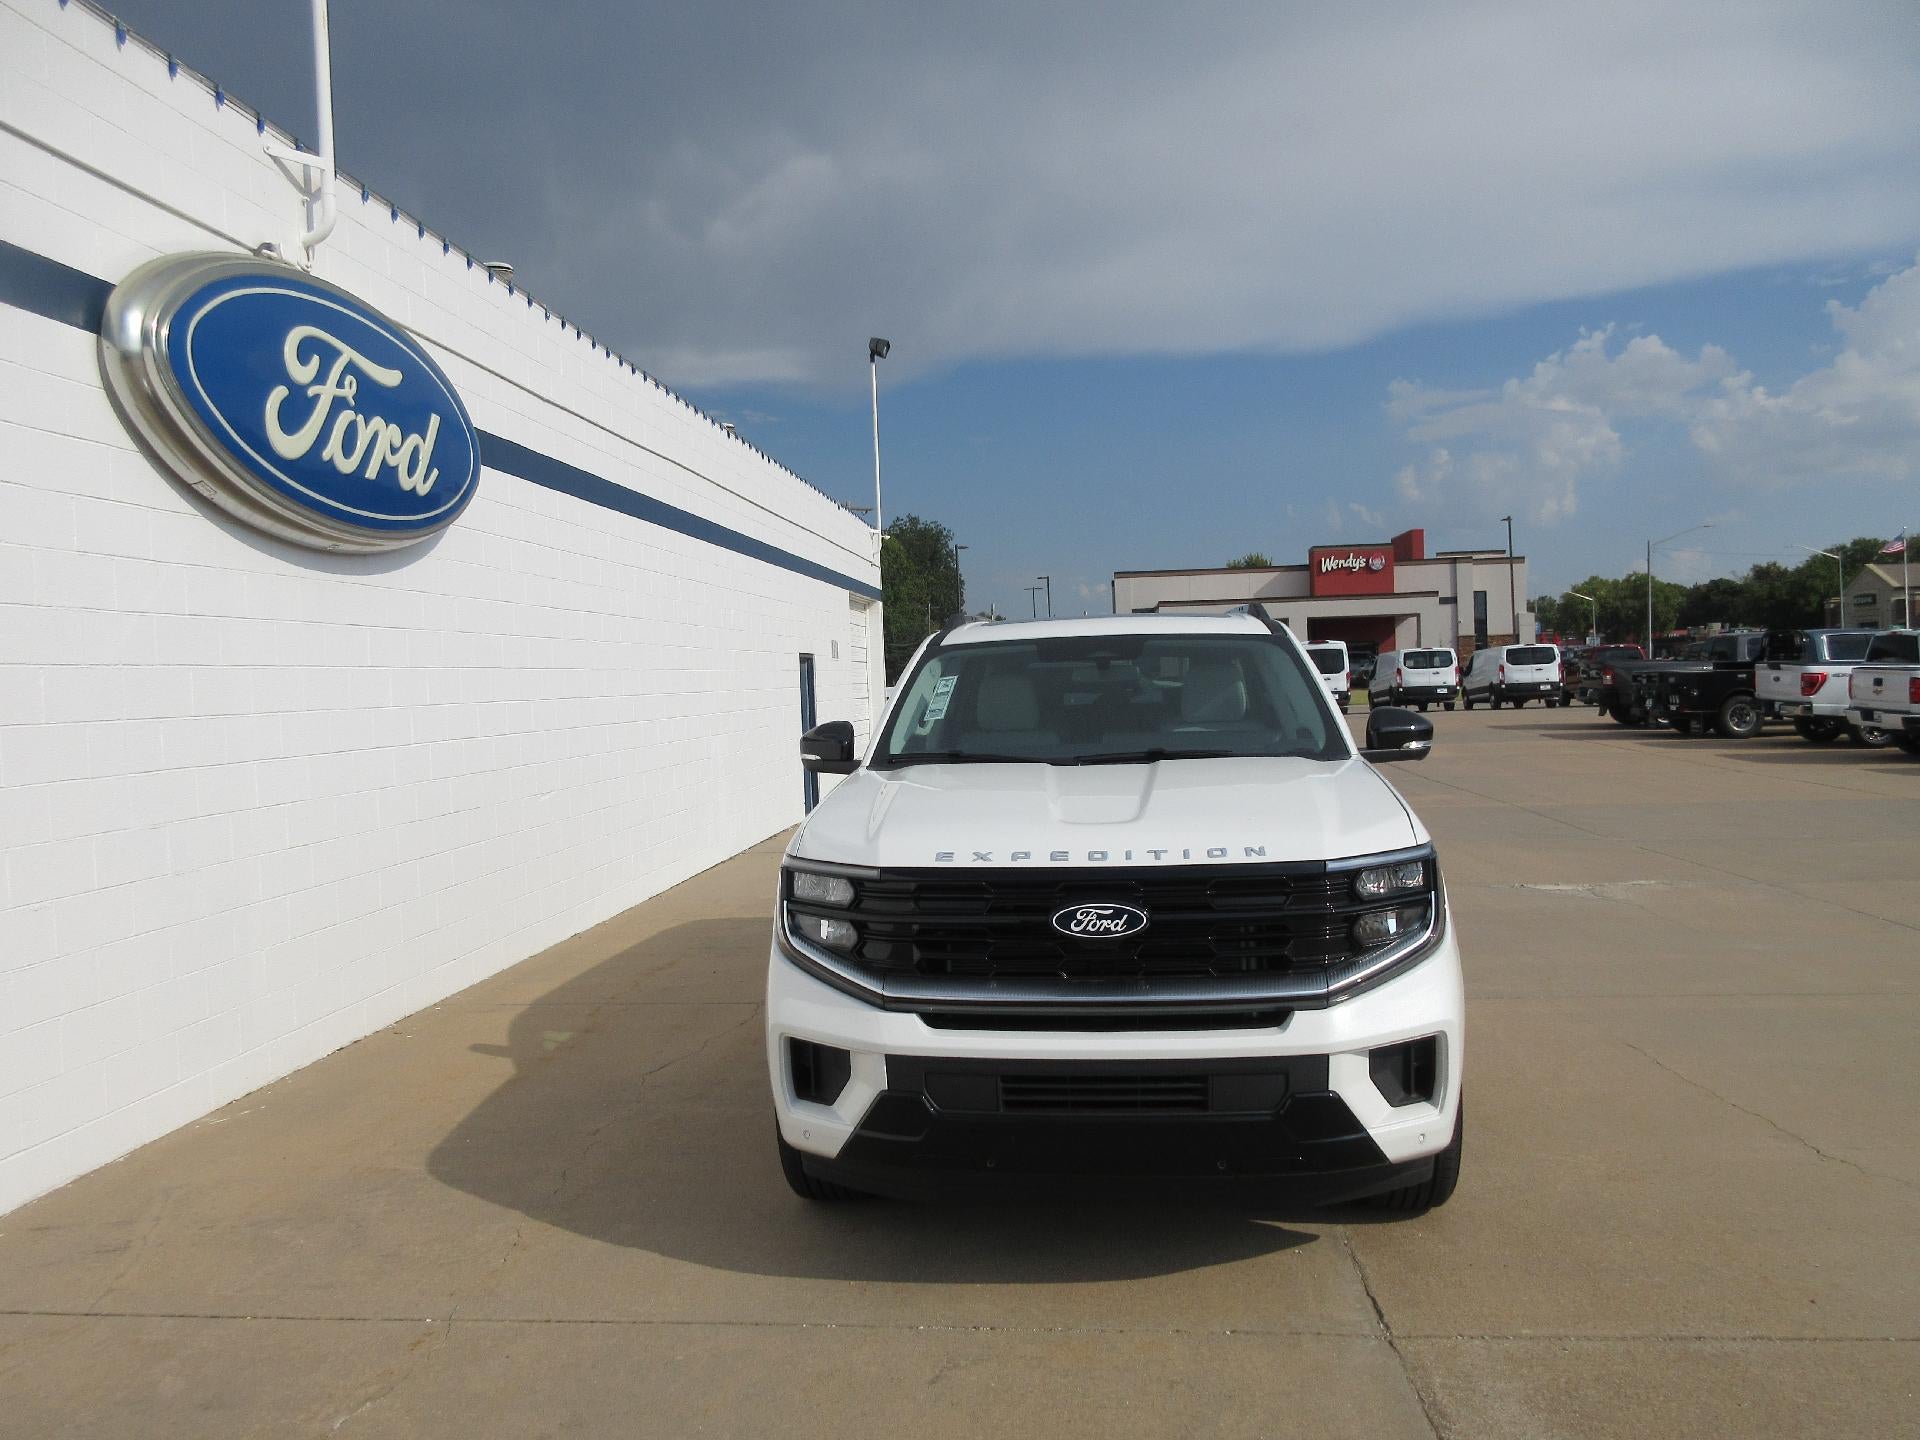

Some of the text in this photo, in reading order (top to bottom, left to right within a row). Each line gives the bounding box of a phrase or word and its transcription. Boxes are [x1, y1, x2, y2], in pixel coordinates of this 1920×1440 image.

[265, 325, 440, 497] Ford
[1321, 553, 1366, 573] Wendy's
[935, 846, 1267, 863] EXPEDITION
[1070, 908, 1128, 931] Ford
